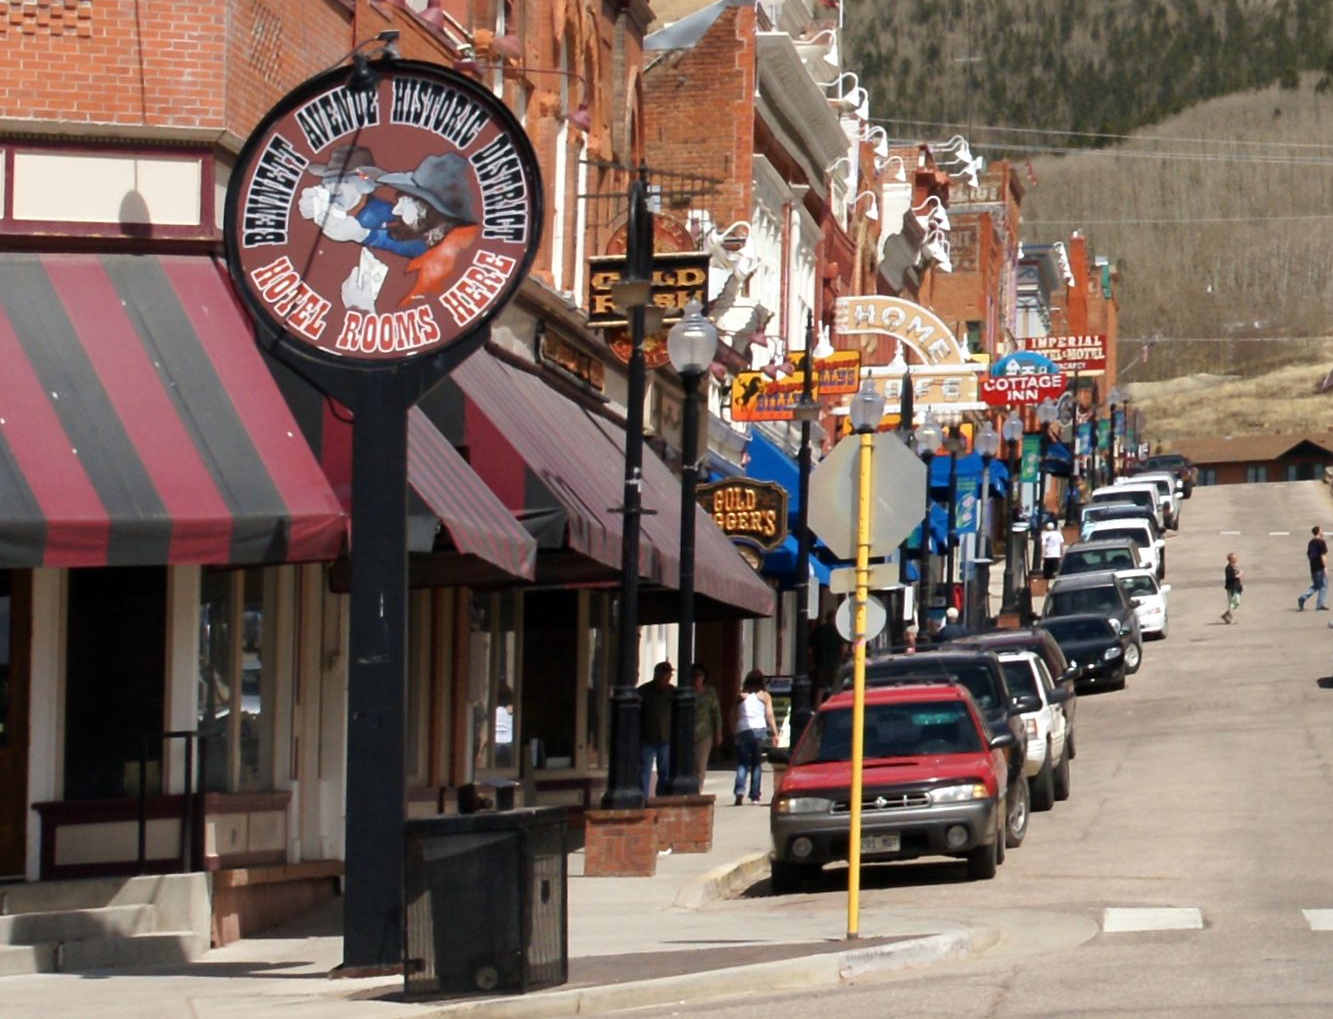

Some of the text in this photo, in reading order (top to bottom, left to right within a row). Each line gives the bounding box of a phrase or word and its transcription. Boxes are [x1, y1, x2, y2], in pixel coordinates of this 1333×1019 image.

[243, 78, 529, 248] BENNETT AVENUE HISTORIC DISTRICT
[592, 268, 706, 291] GLD
[251, 250, 516, 353] HOTEL ROOMS HERE
[593, 290, 705, 315] RSH
[854, 304, 951, 366] HOME
[1032, 335, 1102, 349] IMPERIAL
[883, 377, 963, 401] AFE
[983, 375, 1062, 392] COTTAGE
[1007, 390, 1039, 401] INN
[713, 486, 757, 512] GOLD
[711, 509, 776, 536] GGER'S
